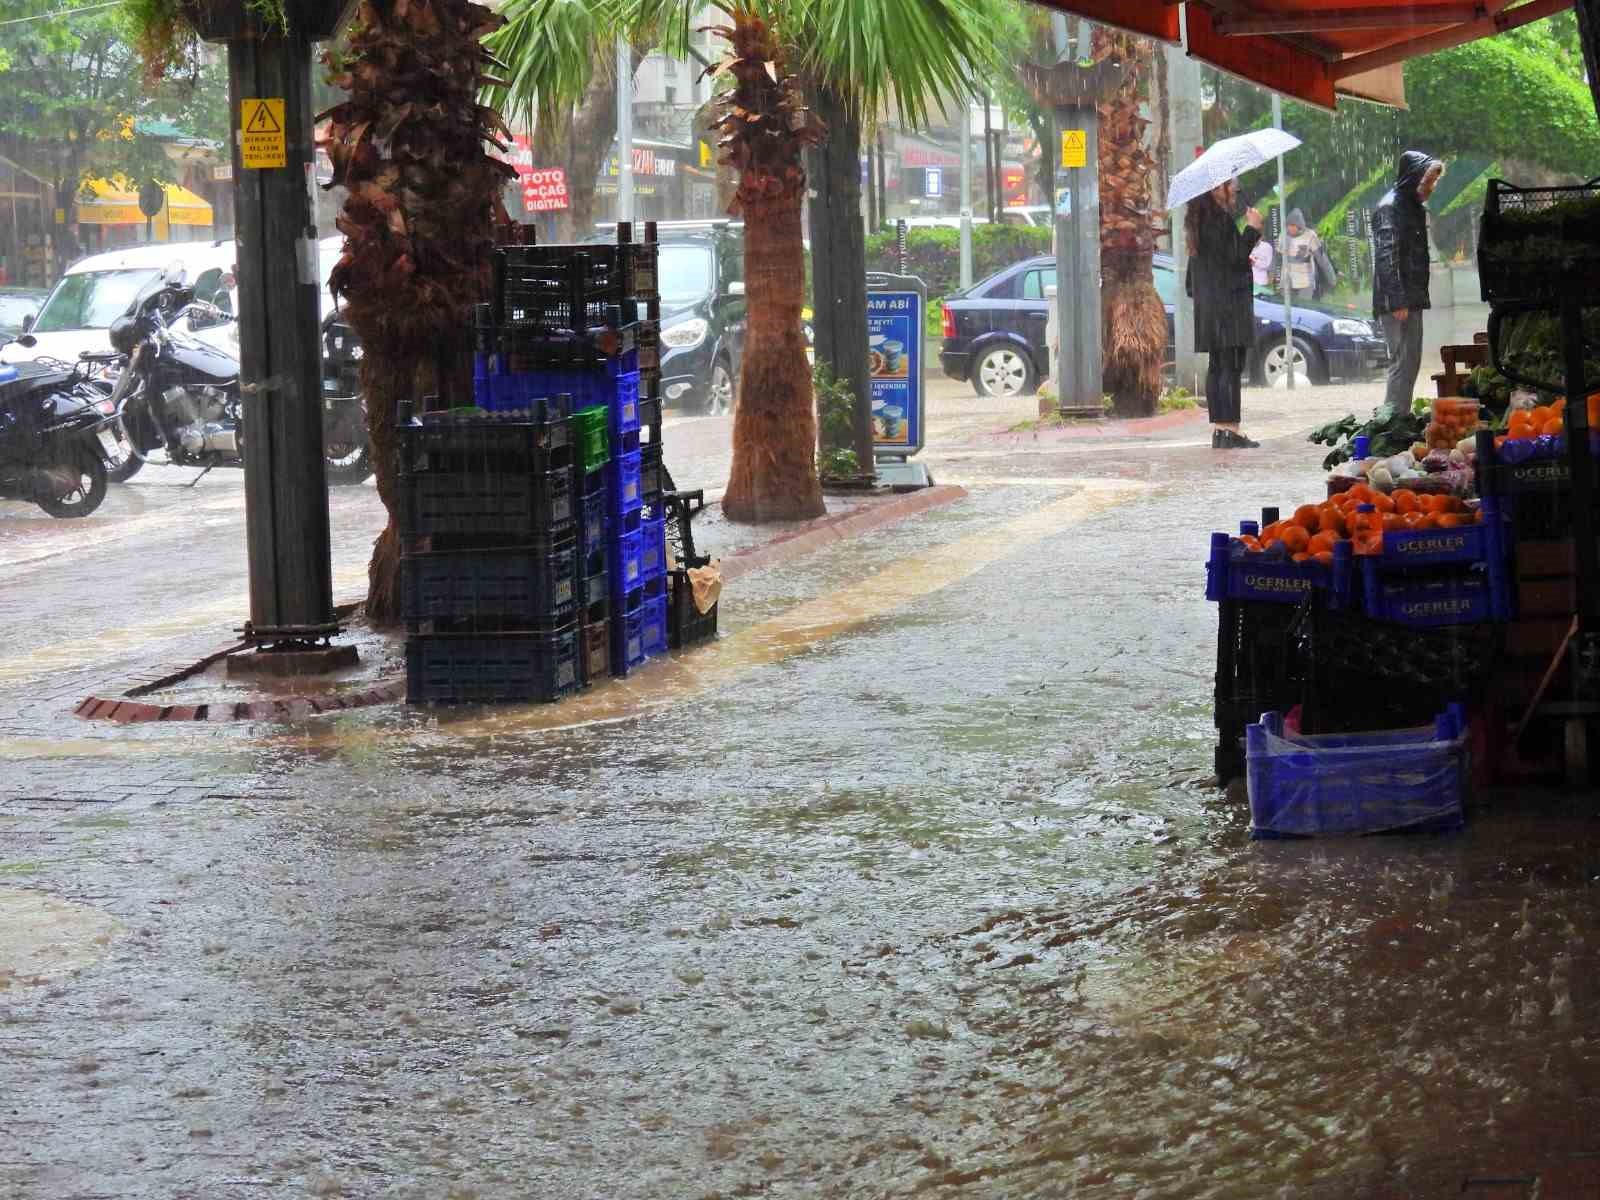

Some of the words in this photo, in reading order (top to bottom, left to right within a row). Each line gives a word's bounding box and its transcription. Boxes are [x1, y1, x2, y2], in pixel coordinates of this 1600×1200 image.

[523, 170, 563, 184] FOTO
[866, 299, 887, 310] AM
[889, 297, 909, 310] ABİ
